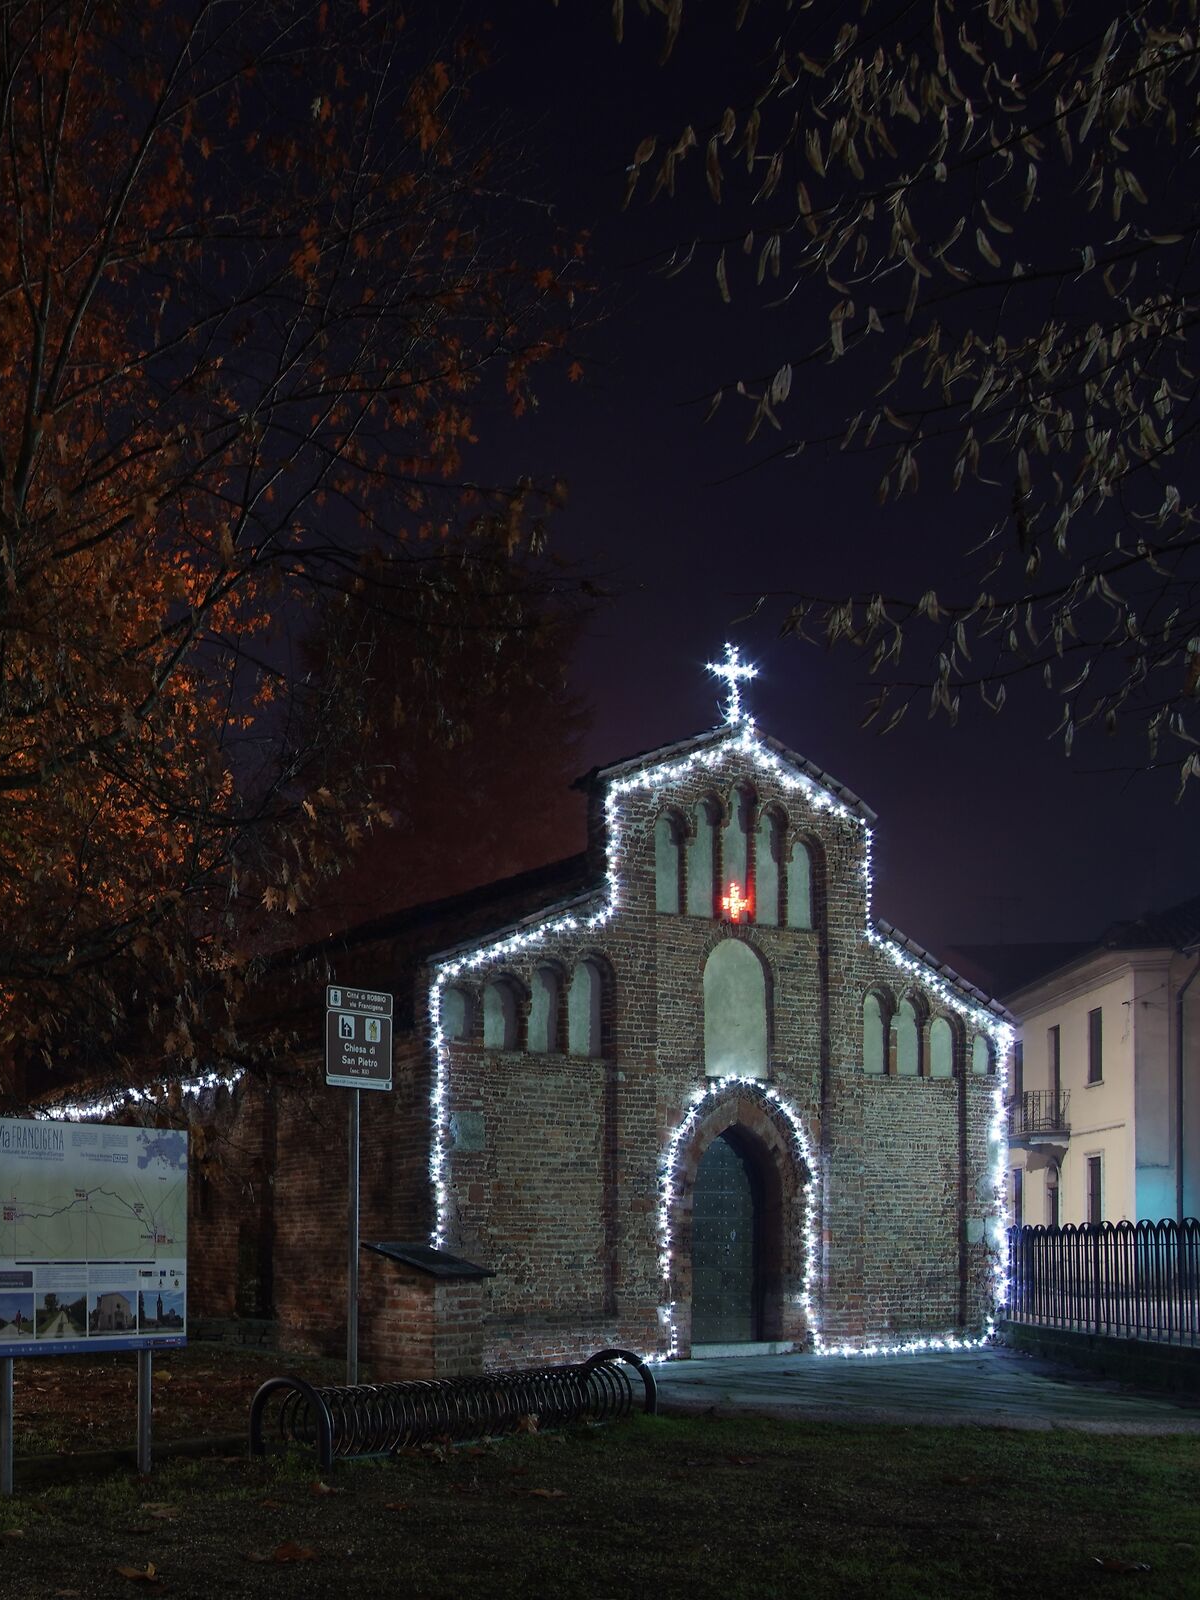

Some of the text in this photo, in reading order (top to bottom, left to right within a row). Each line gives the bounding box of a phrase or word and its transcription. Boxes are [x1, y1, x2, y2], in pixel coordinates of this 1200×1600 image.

[367, 993, 386, 1003] ROBBIO
[358, 1001, 384, 1011] Francigena
[344, 1043, 376, 1055] Chiesa di
[342, 1055, 377, 1067] San Pietro
[12, 1125, 64, 1150] FRANCIGENA
